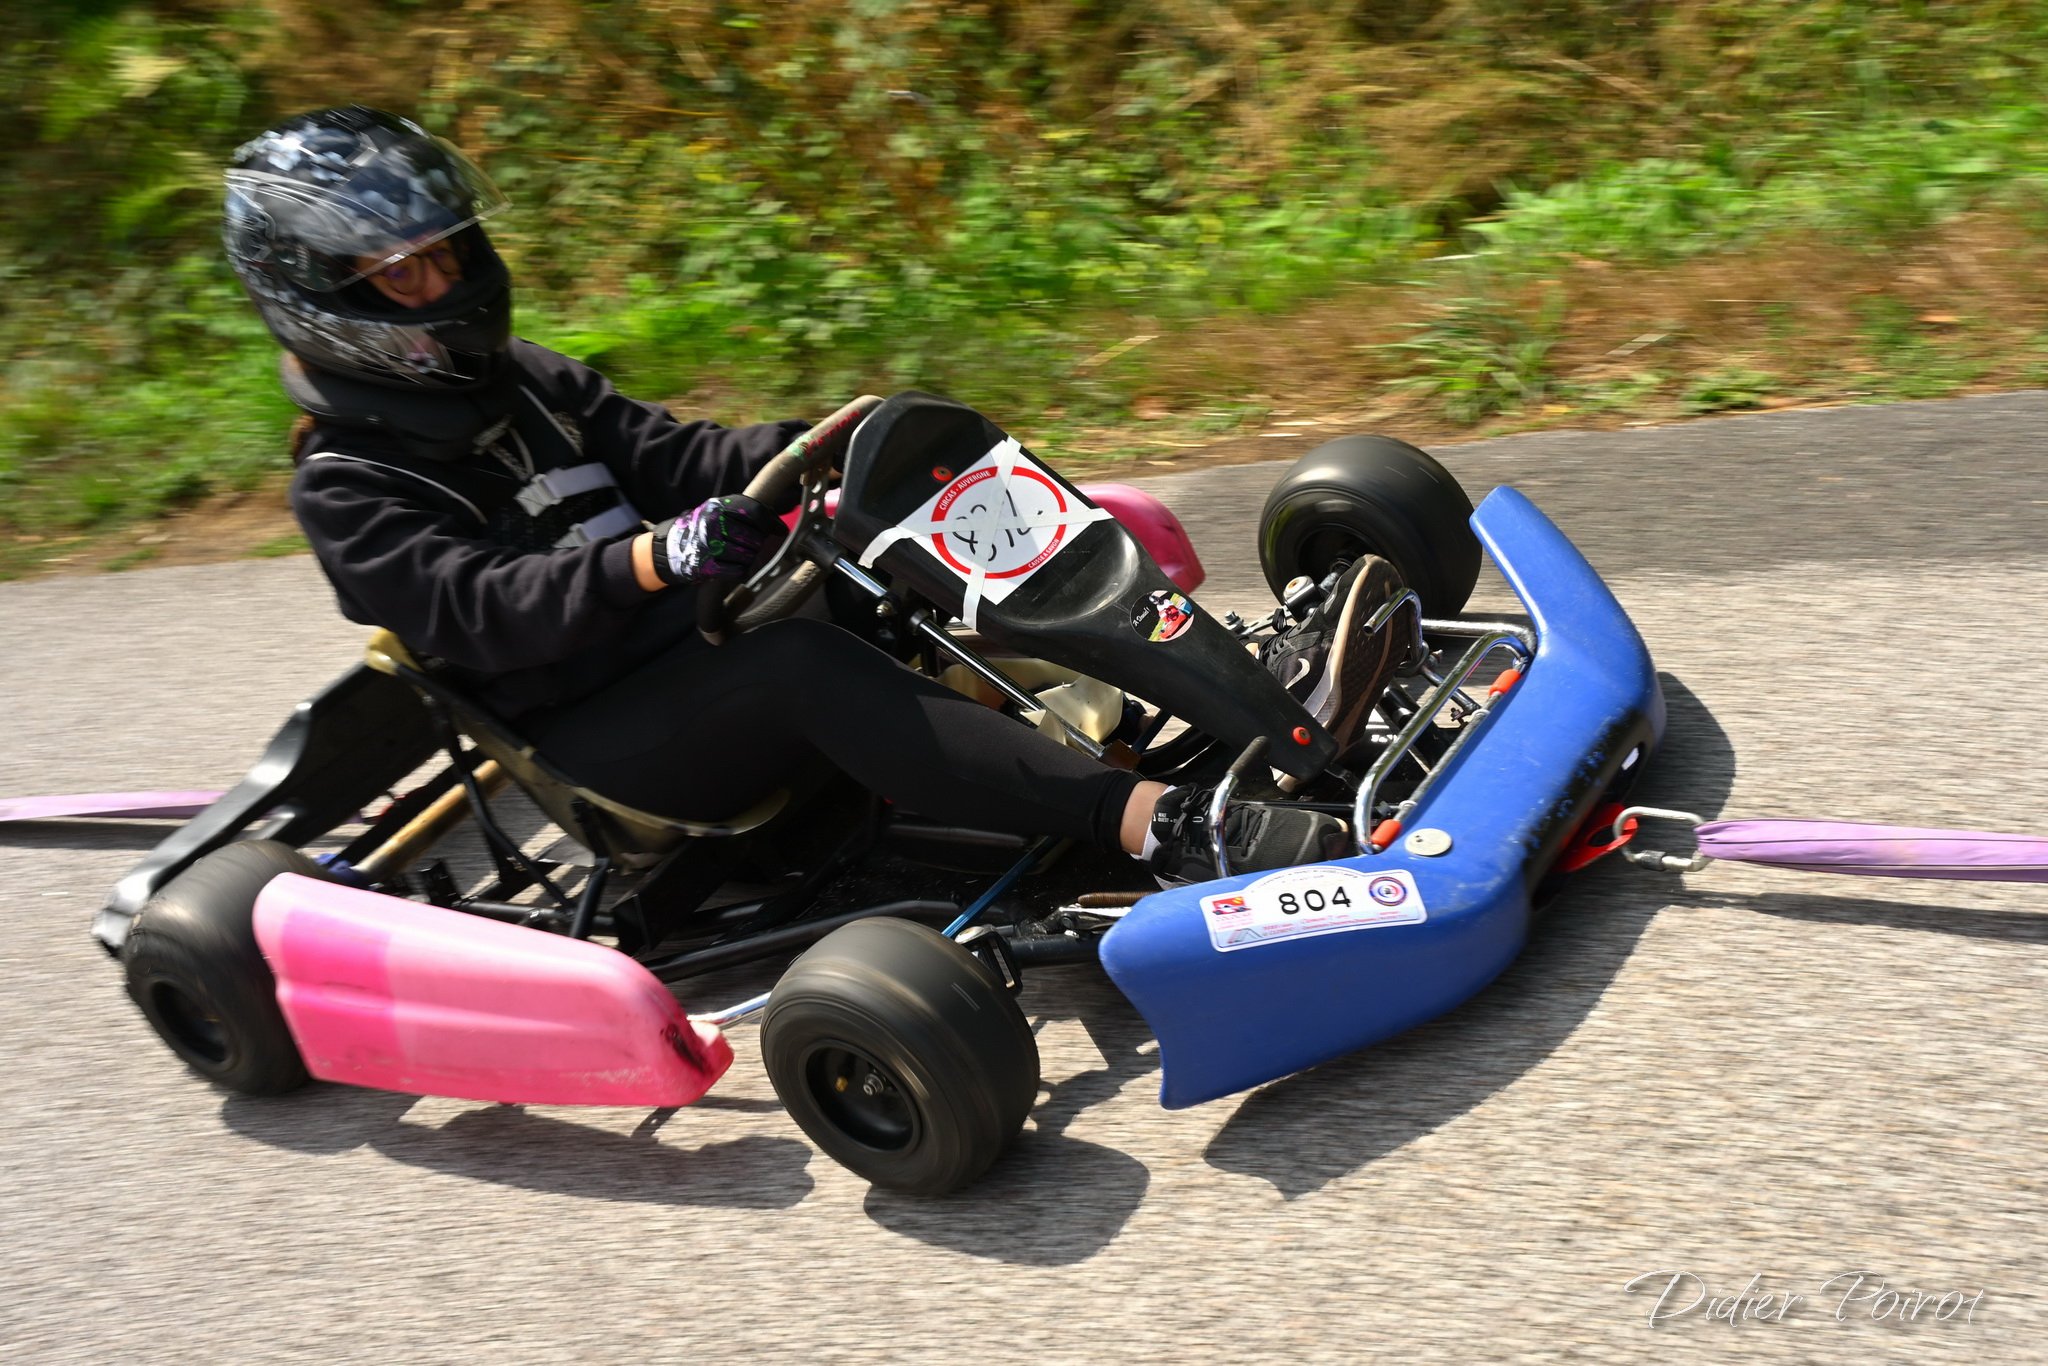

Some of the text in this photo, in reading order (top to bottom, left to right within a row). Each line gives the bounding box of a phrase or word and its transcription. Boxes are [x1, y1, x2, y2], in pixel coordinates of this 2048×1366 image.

[939, 470, 992, 510] CIRCAS AUVERGNE
[1028, 554, 1045, 569] CAISSE
[1045, 538, 1060, 555] SAVON
[1279, 886, 1351, 915] 804
